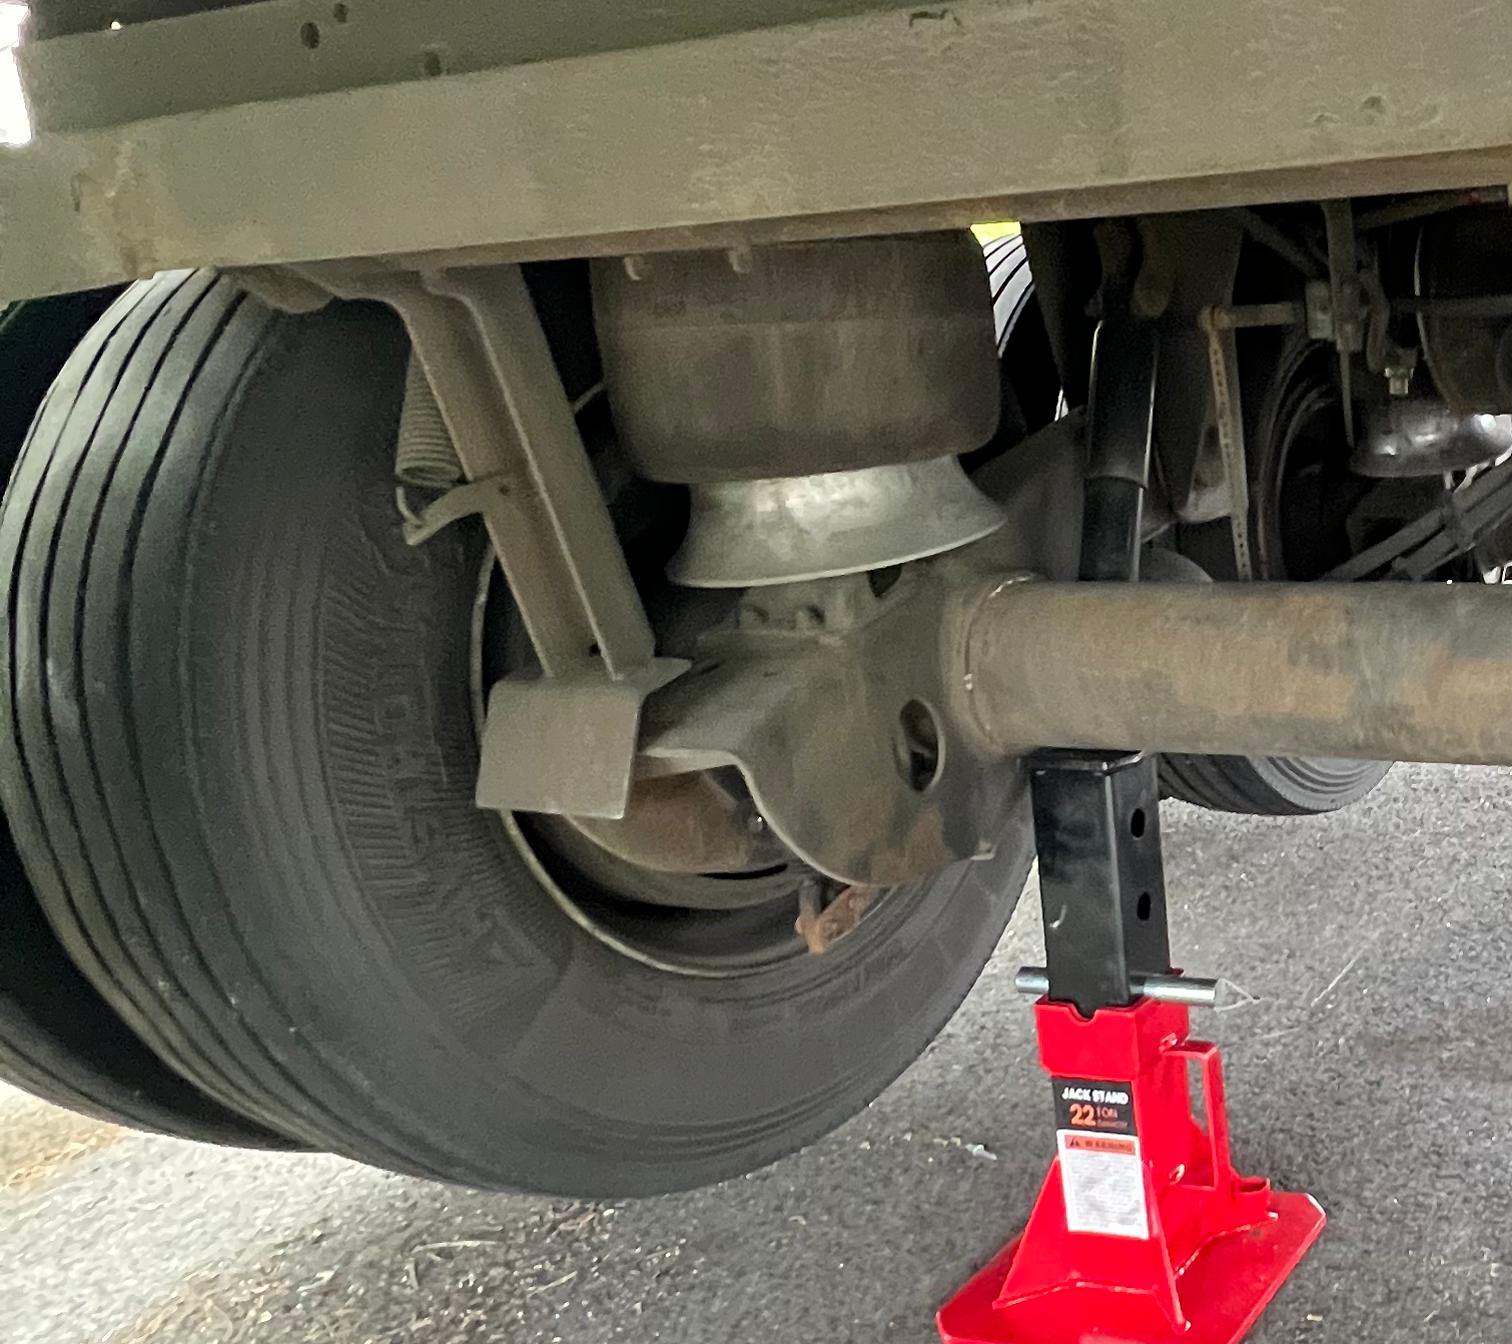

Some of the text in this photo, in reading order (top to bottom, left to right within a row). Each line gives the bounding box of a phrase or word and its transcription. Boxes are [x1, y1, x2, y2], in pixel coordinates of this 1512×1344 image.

[1062, 1087, 1129, 1105] JACK STAND
[1070, 1103, 1096, 1126] 22
